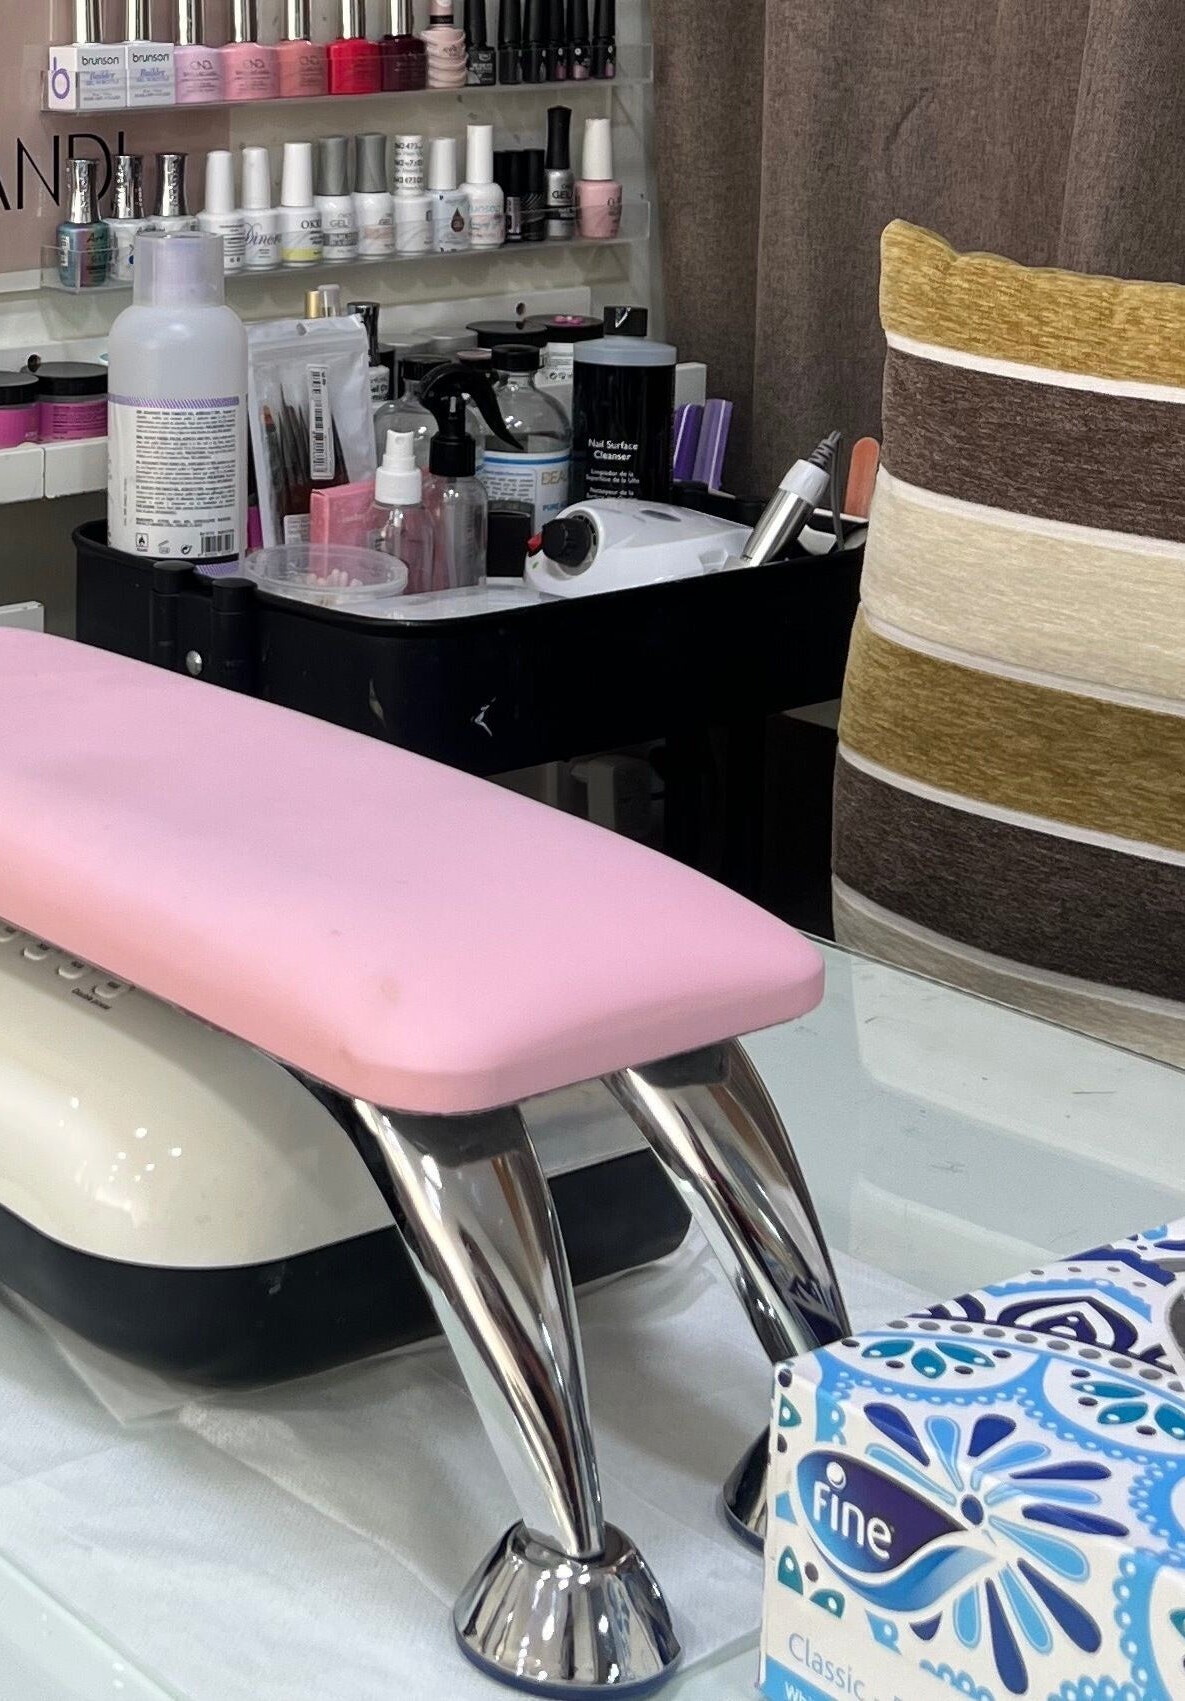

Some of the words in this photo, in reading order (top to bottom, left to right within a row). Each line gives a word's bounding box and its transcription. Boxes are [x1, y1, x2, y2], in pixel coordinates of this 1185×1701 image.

[82, 56, 119, 66] brunson
[132, 53, 169, 63] brunson
[588, 438, 604, 448] Nail
[606, 440, 639, 451] Surface
[593, 450, 632, 461] Cleanser
[788, 1632, 866, 1701] Classic
